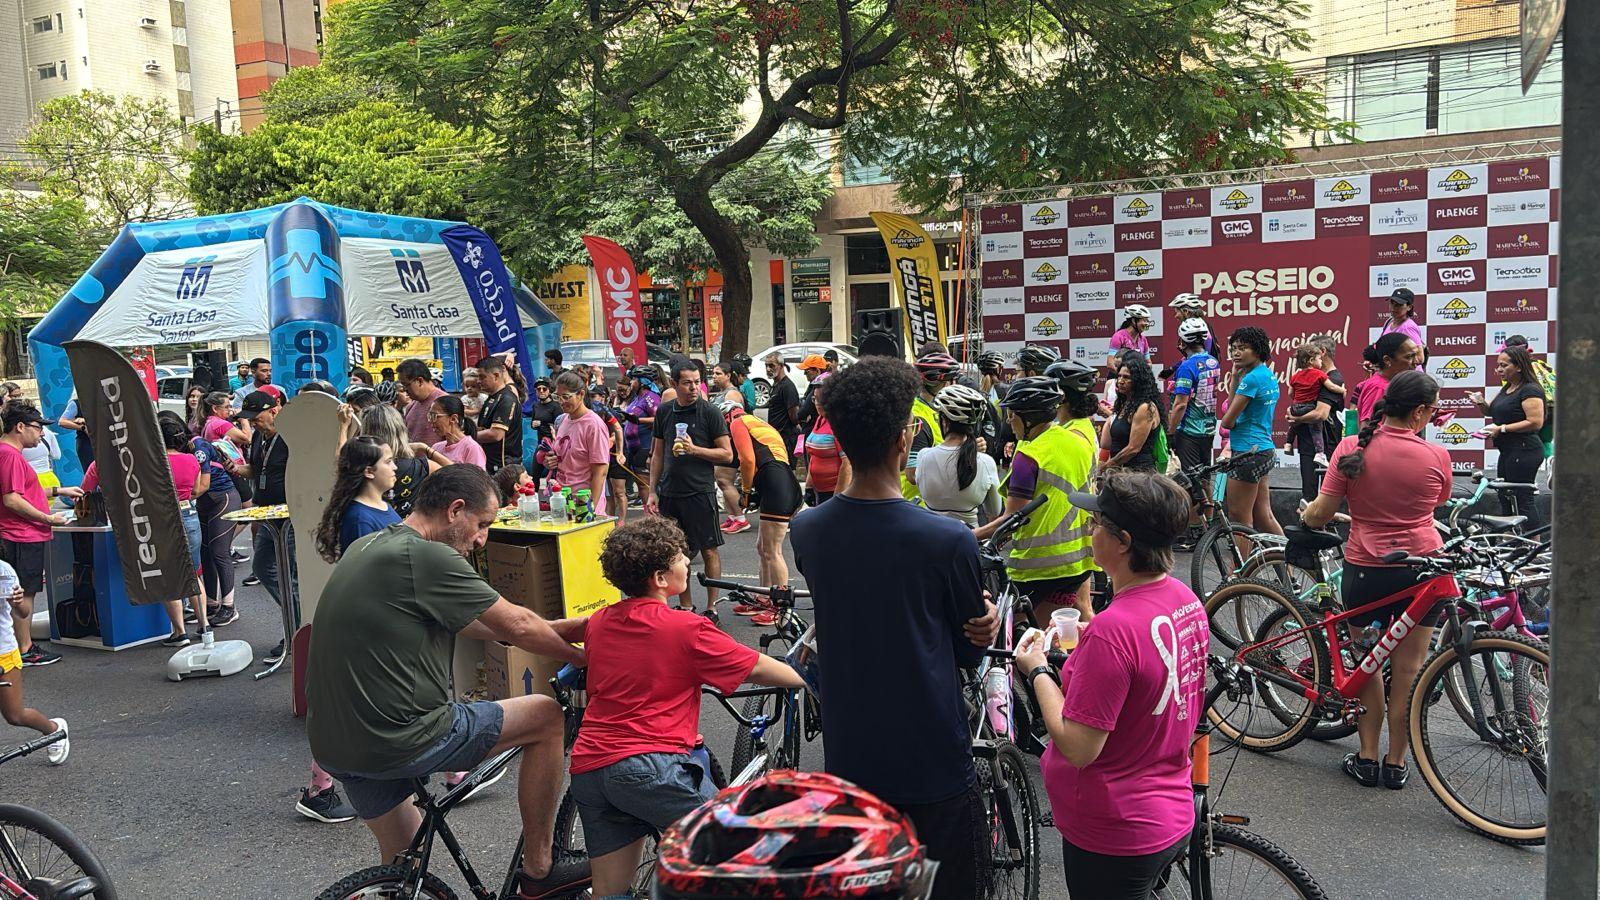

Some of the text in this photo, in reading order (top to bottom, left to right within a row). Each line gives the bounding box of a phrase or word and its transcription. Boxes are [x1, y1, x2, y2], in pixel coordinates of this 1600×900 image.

[1436, 207, 1479, 218] PLAENGE
[1224, 222, 1250, 232] GMC
[1121, 232, 1155, 241] PLAENGE
[1193, 265, 1335, 295] PASSEIO
[1441, 269, 1471, 279] GMC
[1031, 294, 1063, 303] PLAENGE
[1122, 292, 1136, 300] mini
[391, 303, 460, 319] Santa Casa
[480, 270, 517, 343] preço
[606, 266, 639, 344] GMC
[146, 307, 217, 328] Santa Casa
[923, 310, 938, 341] FM
[1435, 336, 1477, 346] PLAENGE
[1360, 611, 1416, 673] CALOI
[841, 870, 892, 890] FIRST
